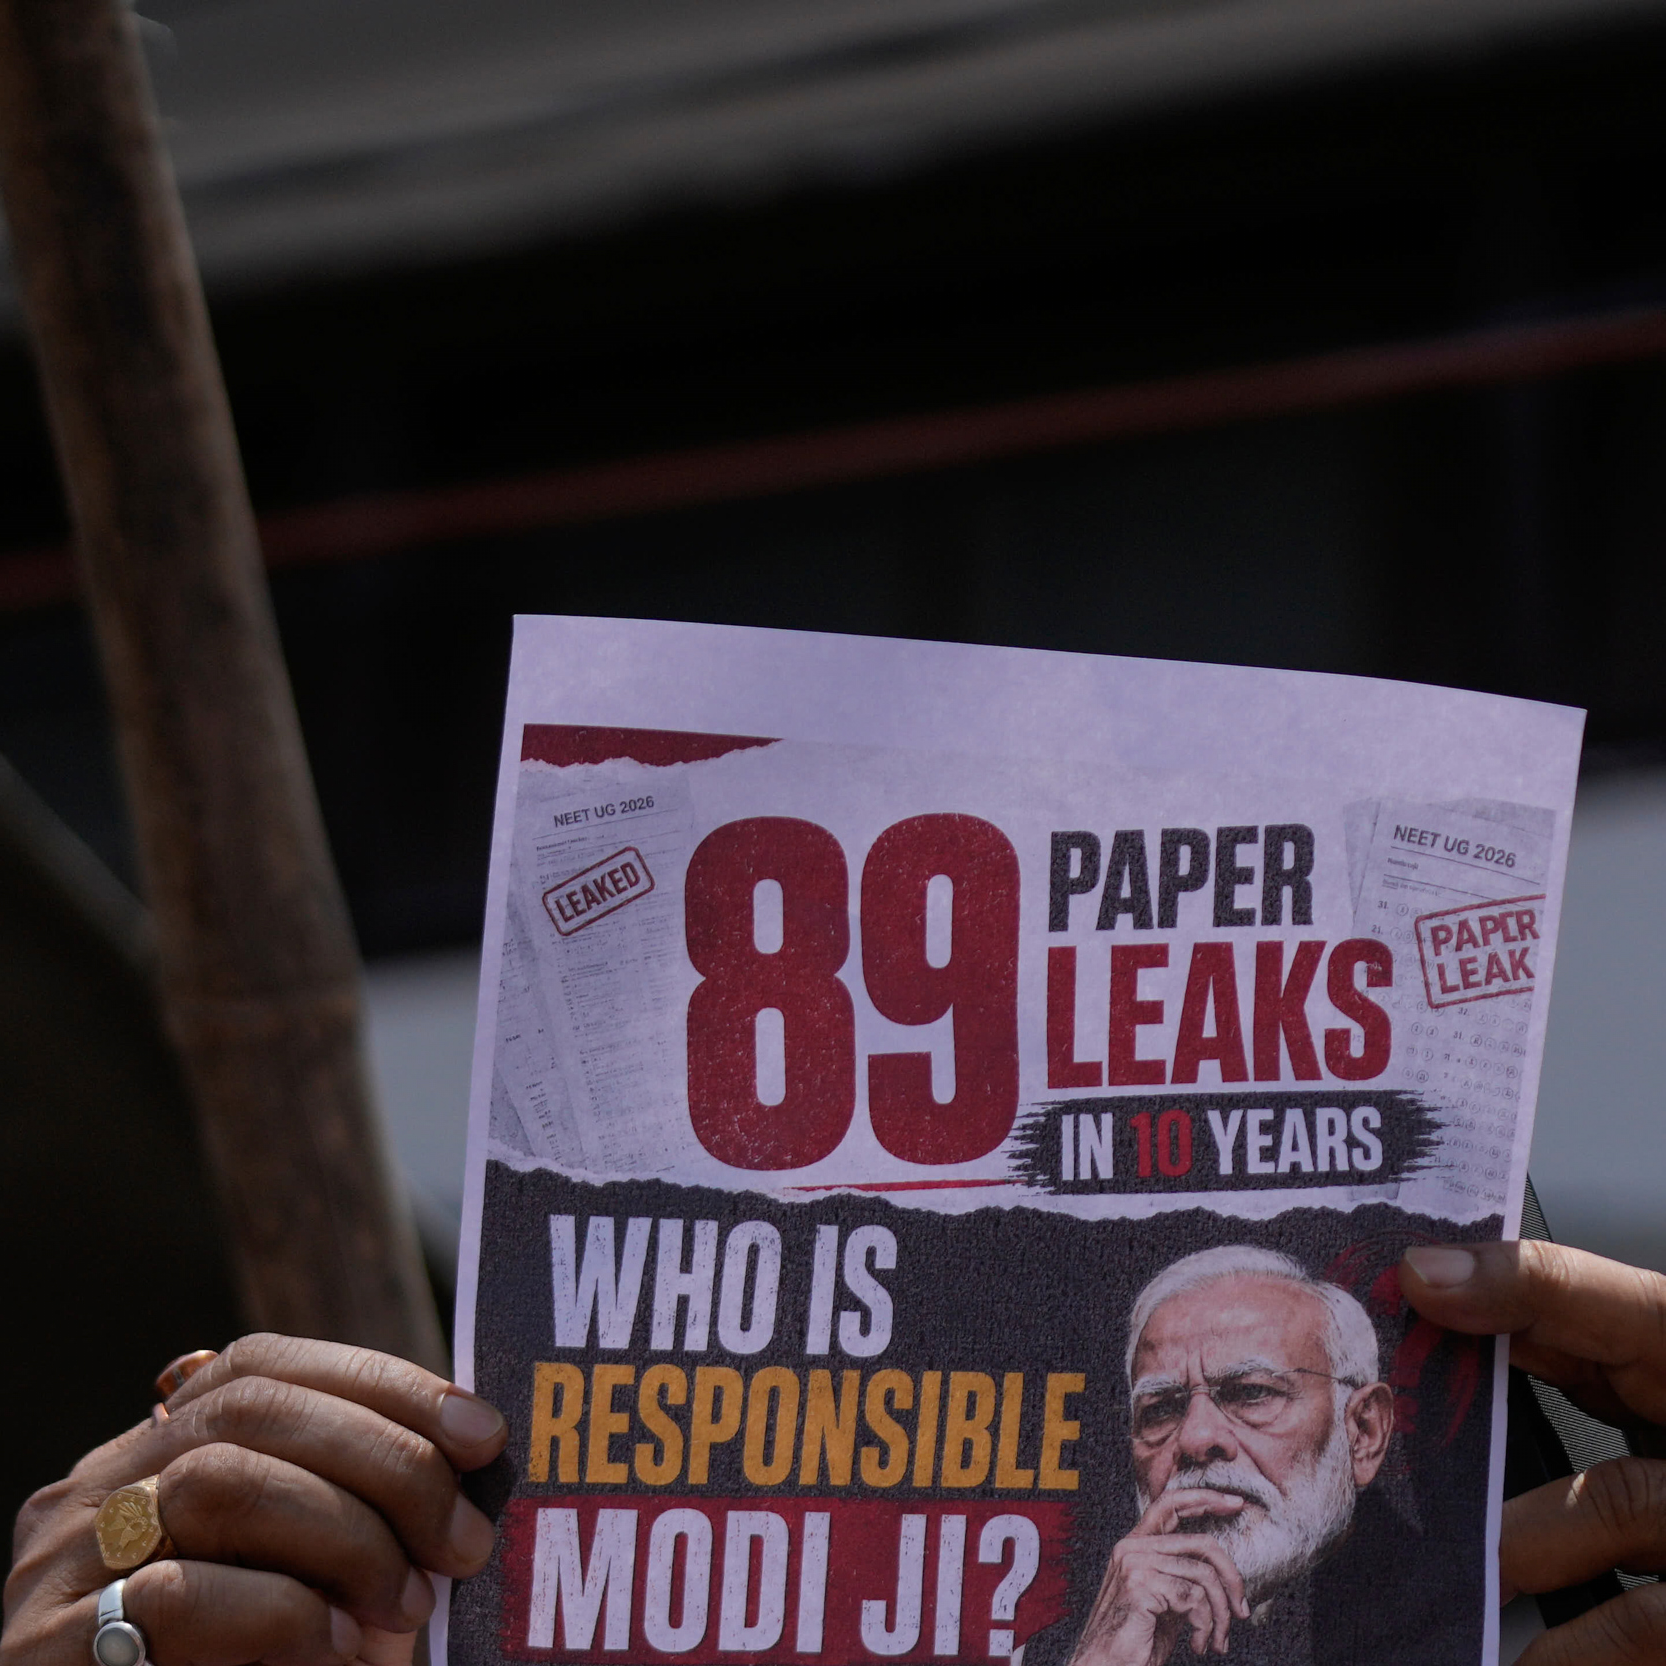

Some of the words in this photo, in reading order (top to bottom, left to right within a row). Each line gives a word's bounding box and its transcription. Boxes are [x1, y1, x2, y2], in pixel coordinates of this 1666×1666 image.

[554, 808, 590, 828] NEET
[594, 803, 616, 819] UG
[620, 796, 655, 814] 2026
[1393, 824, 1441, 848] NEET
[1444, 836, 1469, 855] UG
[1473, 843, 1517, 868] 2026
[554, 861, 641, 923] LEAKED
[1048, 823, 1315, 933] PAPER
[685, 813, 1021, 1171] 89
[1048, 938, 1394, 1089] LEAKS
[1437, 946, 1535, 994] LEAK
[1061, 1113, 1113, 1181] IN
[1129, 1109, 1192, 1178] 10
[1206, 1105, 1383, 1175] YEARS
[549, 1214, 782, 1355] WHO
[806, 1223, 898, 1357] IS
[528, 1362, 1087, 1490] RESPONSIBLE
[527, 1507, 831, 1654] MODI
[860, 1513, 1041, 1657] JI?
